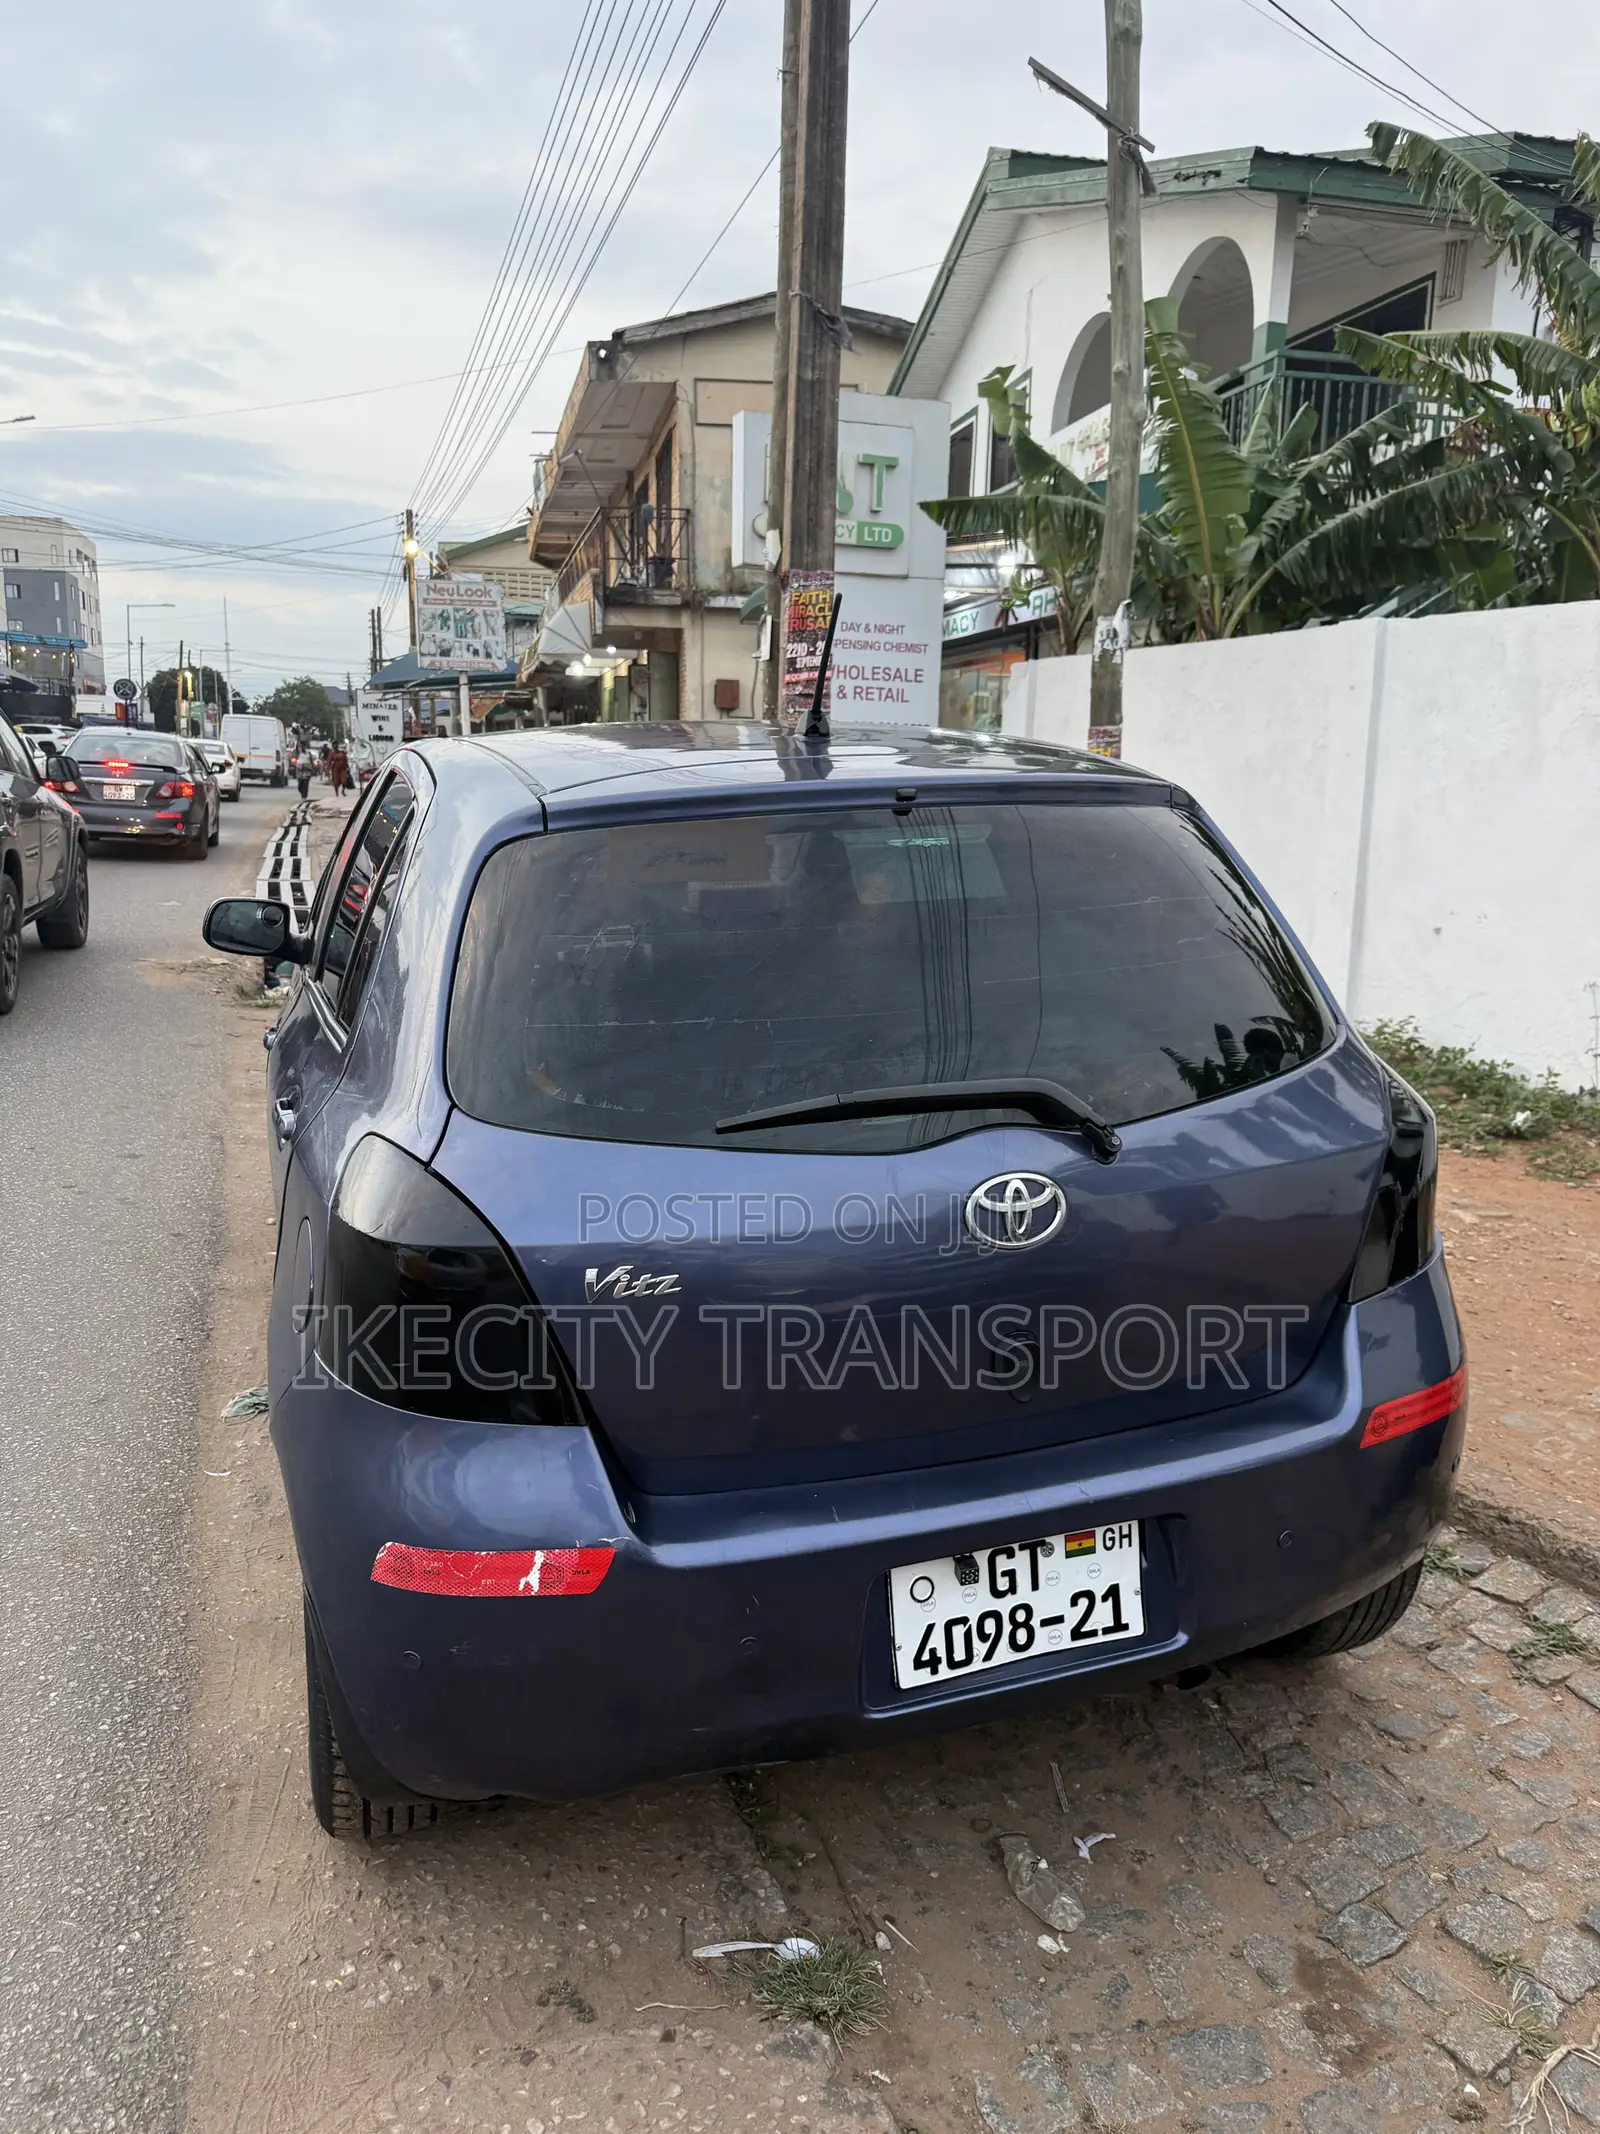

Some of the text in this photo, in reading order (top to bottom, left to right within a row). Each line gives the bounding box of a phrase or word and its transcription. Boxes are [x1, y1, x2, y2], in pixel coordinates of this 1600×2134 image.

[863, 526, 893, 542] LTD
[790, 589, 830, 605] FAITH
[840, 621, 906, 635] DAY & NIGHT
[833, 638, 929, 654] PENSING CHEMIST
[831, 665, 925, 684] HOLESALE
[836, 685, 910, 703] & RETAIL
[371, 714, 390, 722] WINE
[584, 1265, 683, 1304] Vitz
[987, 1523, 1134, 1600] GT GH
[912, 1582, 1130, 1676] 4098-21
